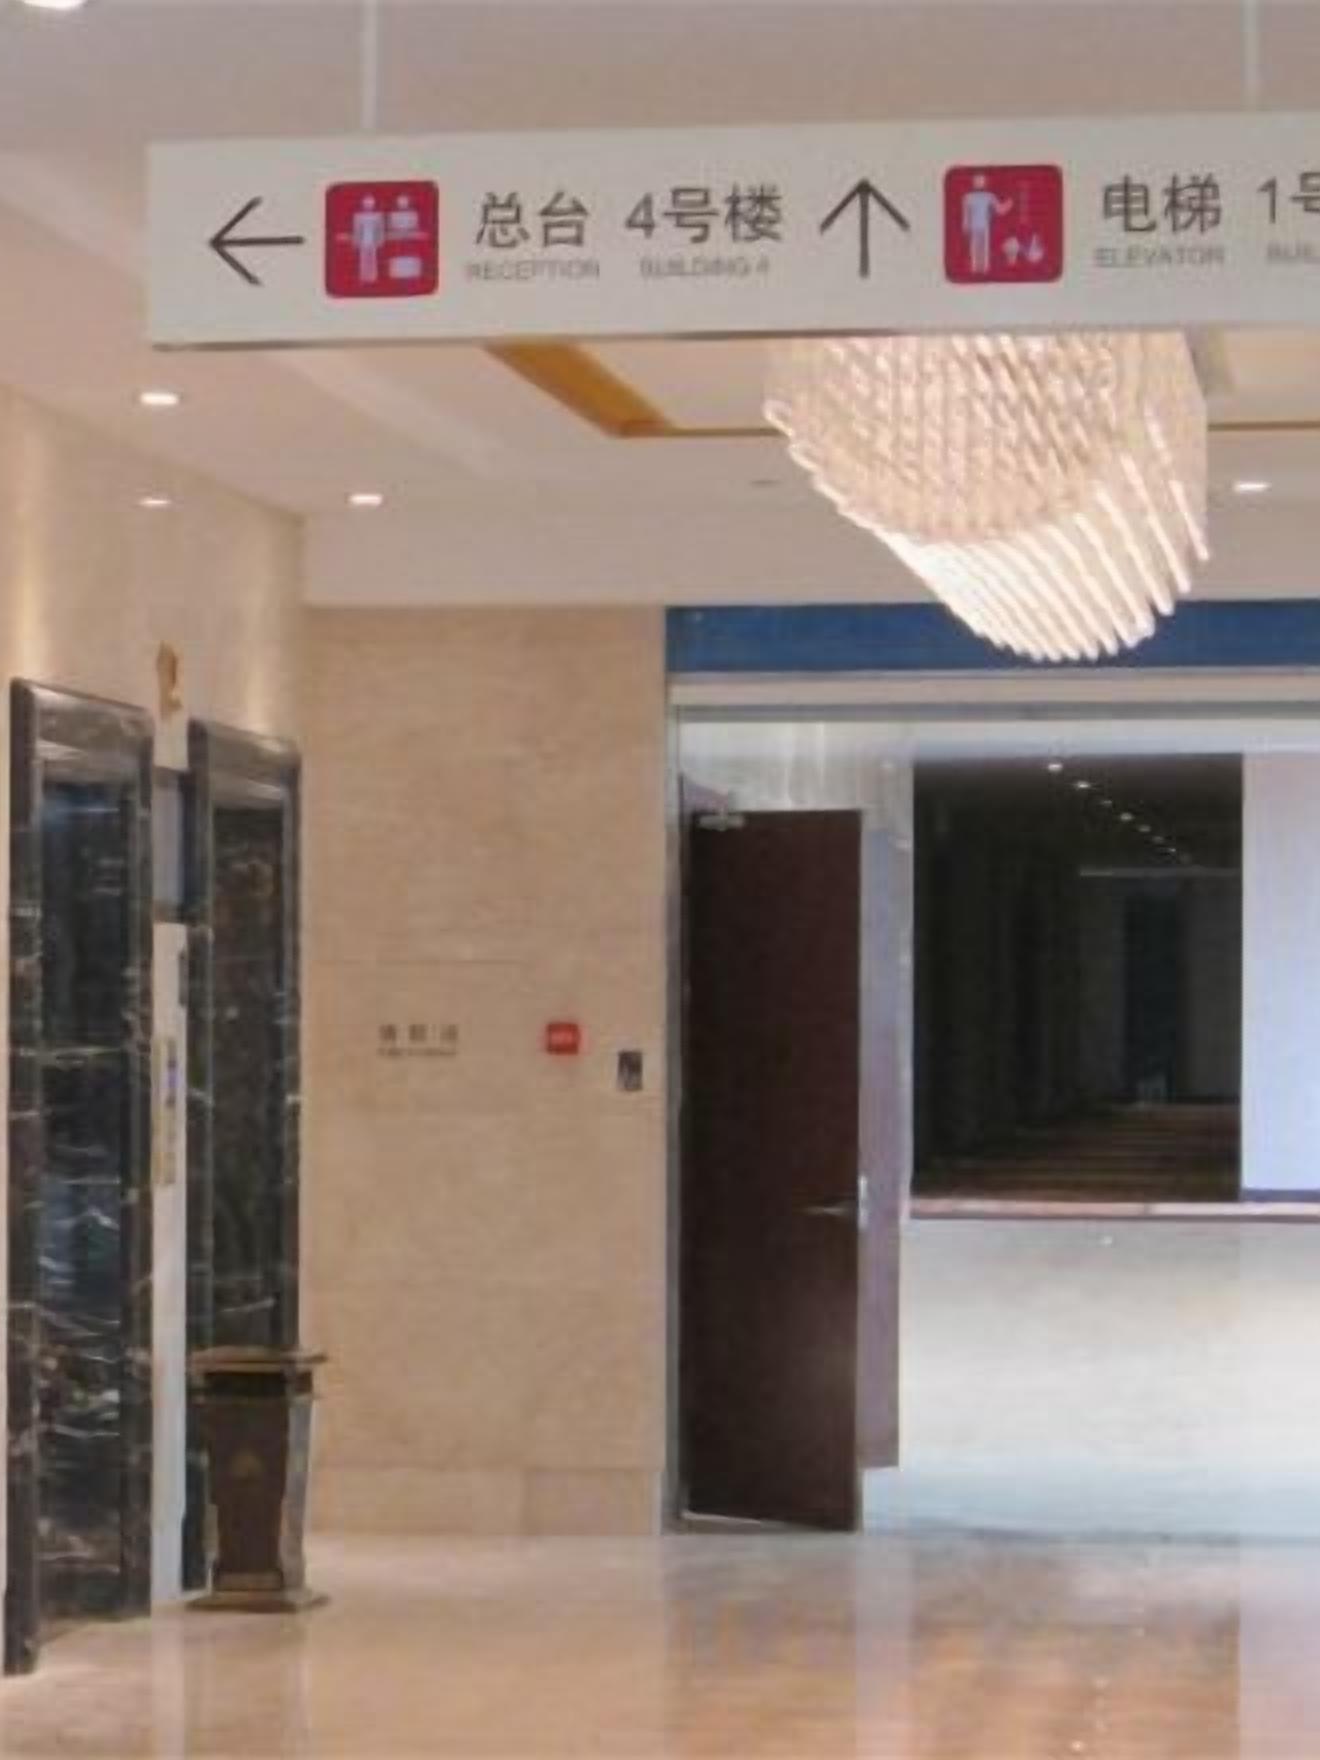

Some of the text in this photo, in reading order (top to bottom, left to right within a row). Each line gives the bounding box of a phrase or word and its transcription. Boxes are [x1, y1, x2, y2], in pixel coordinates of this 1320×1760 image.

[476, 183, 783, 248] 总台 4号楼
[1103, 171, 1320, 234] 电梯 1号
[465, 258, 600, 281] RECEPTION
[1093, 246, 1225, 268] ELEVATOR
